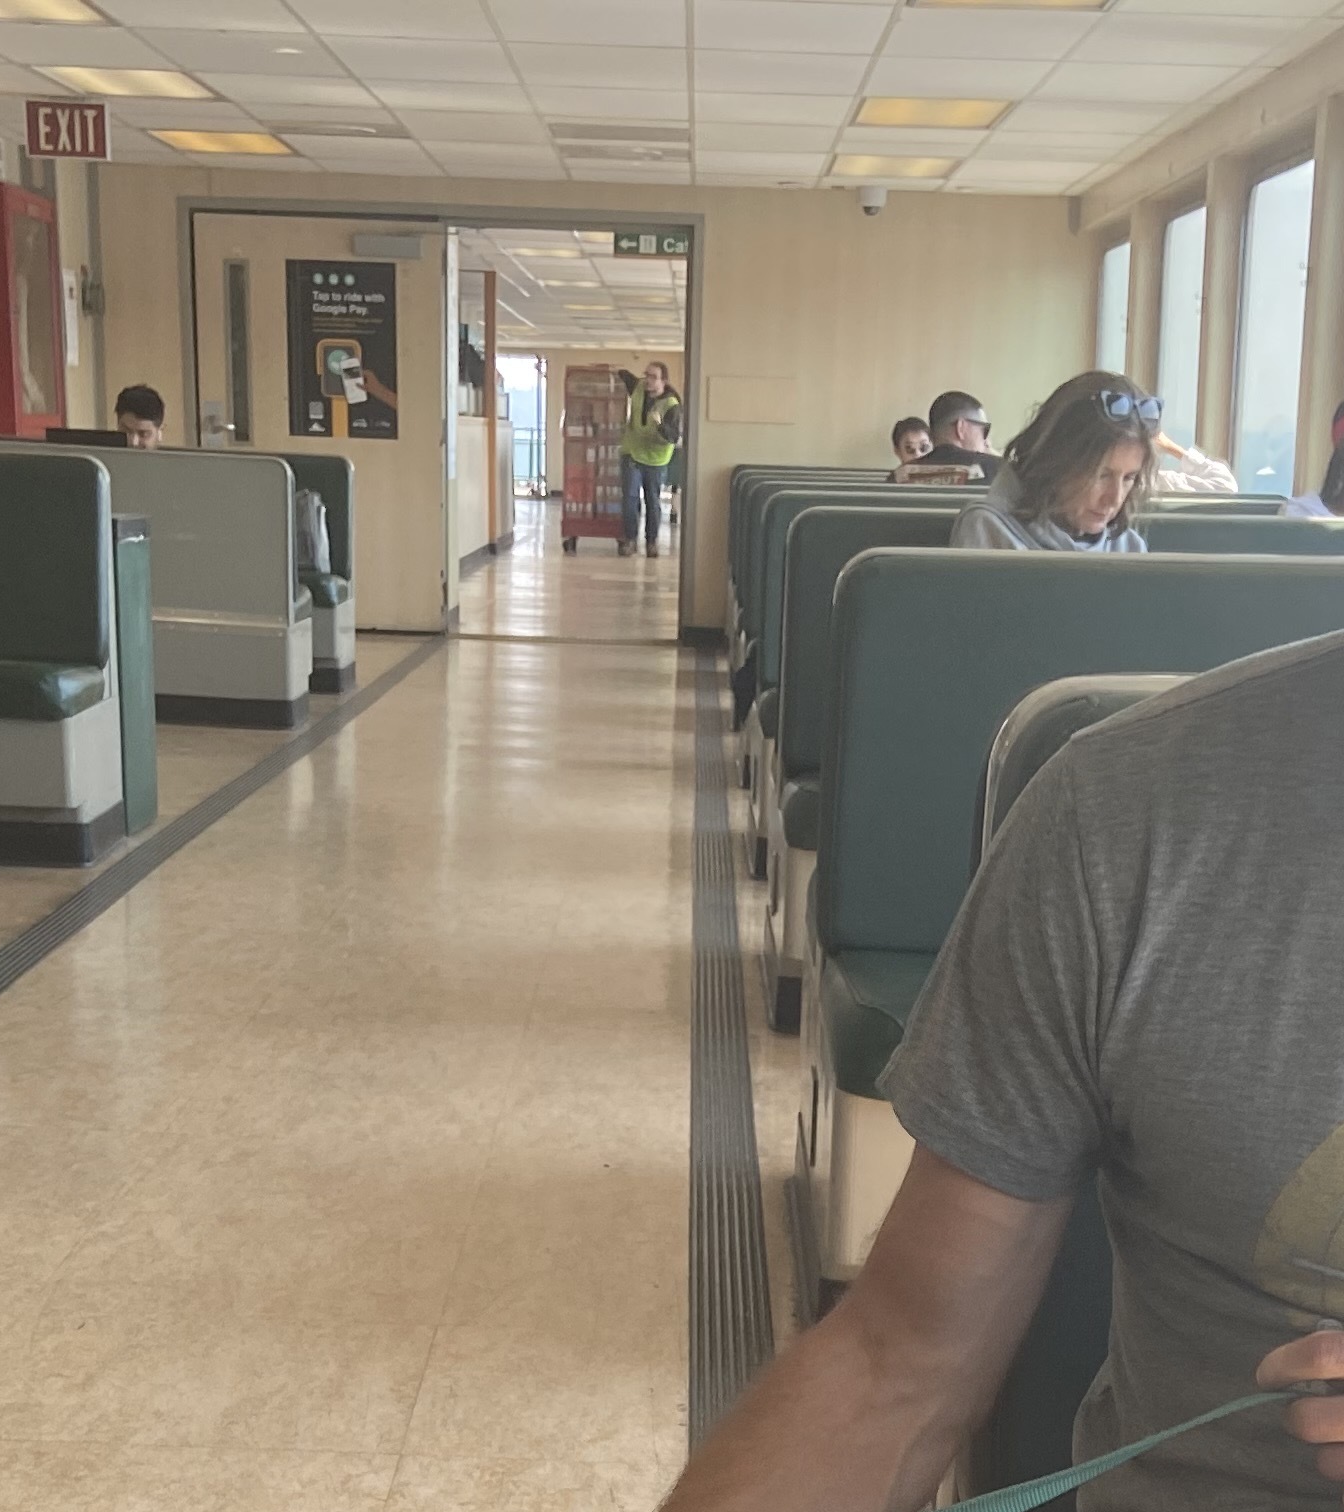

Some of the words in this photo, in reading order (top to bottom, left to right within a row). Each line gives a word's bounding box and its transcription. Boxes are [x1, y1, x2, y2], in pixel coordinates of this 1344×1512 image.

[38, 107, 98, 153] EXIT
[312, 290, 330, 302] Tap
[332, 292, 342, 301] to
[343, 291, 363, 302] ride
[364, 293, 386, 303] with
[312, 303, 347, 315] Google
